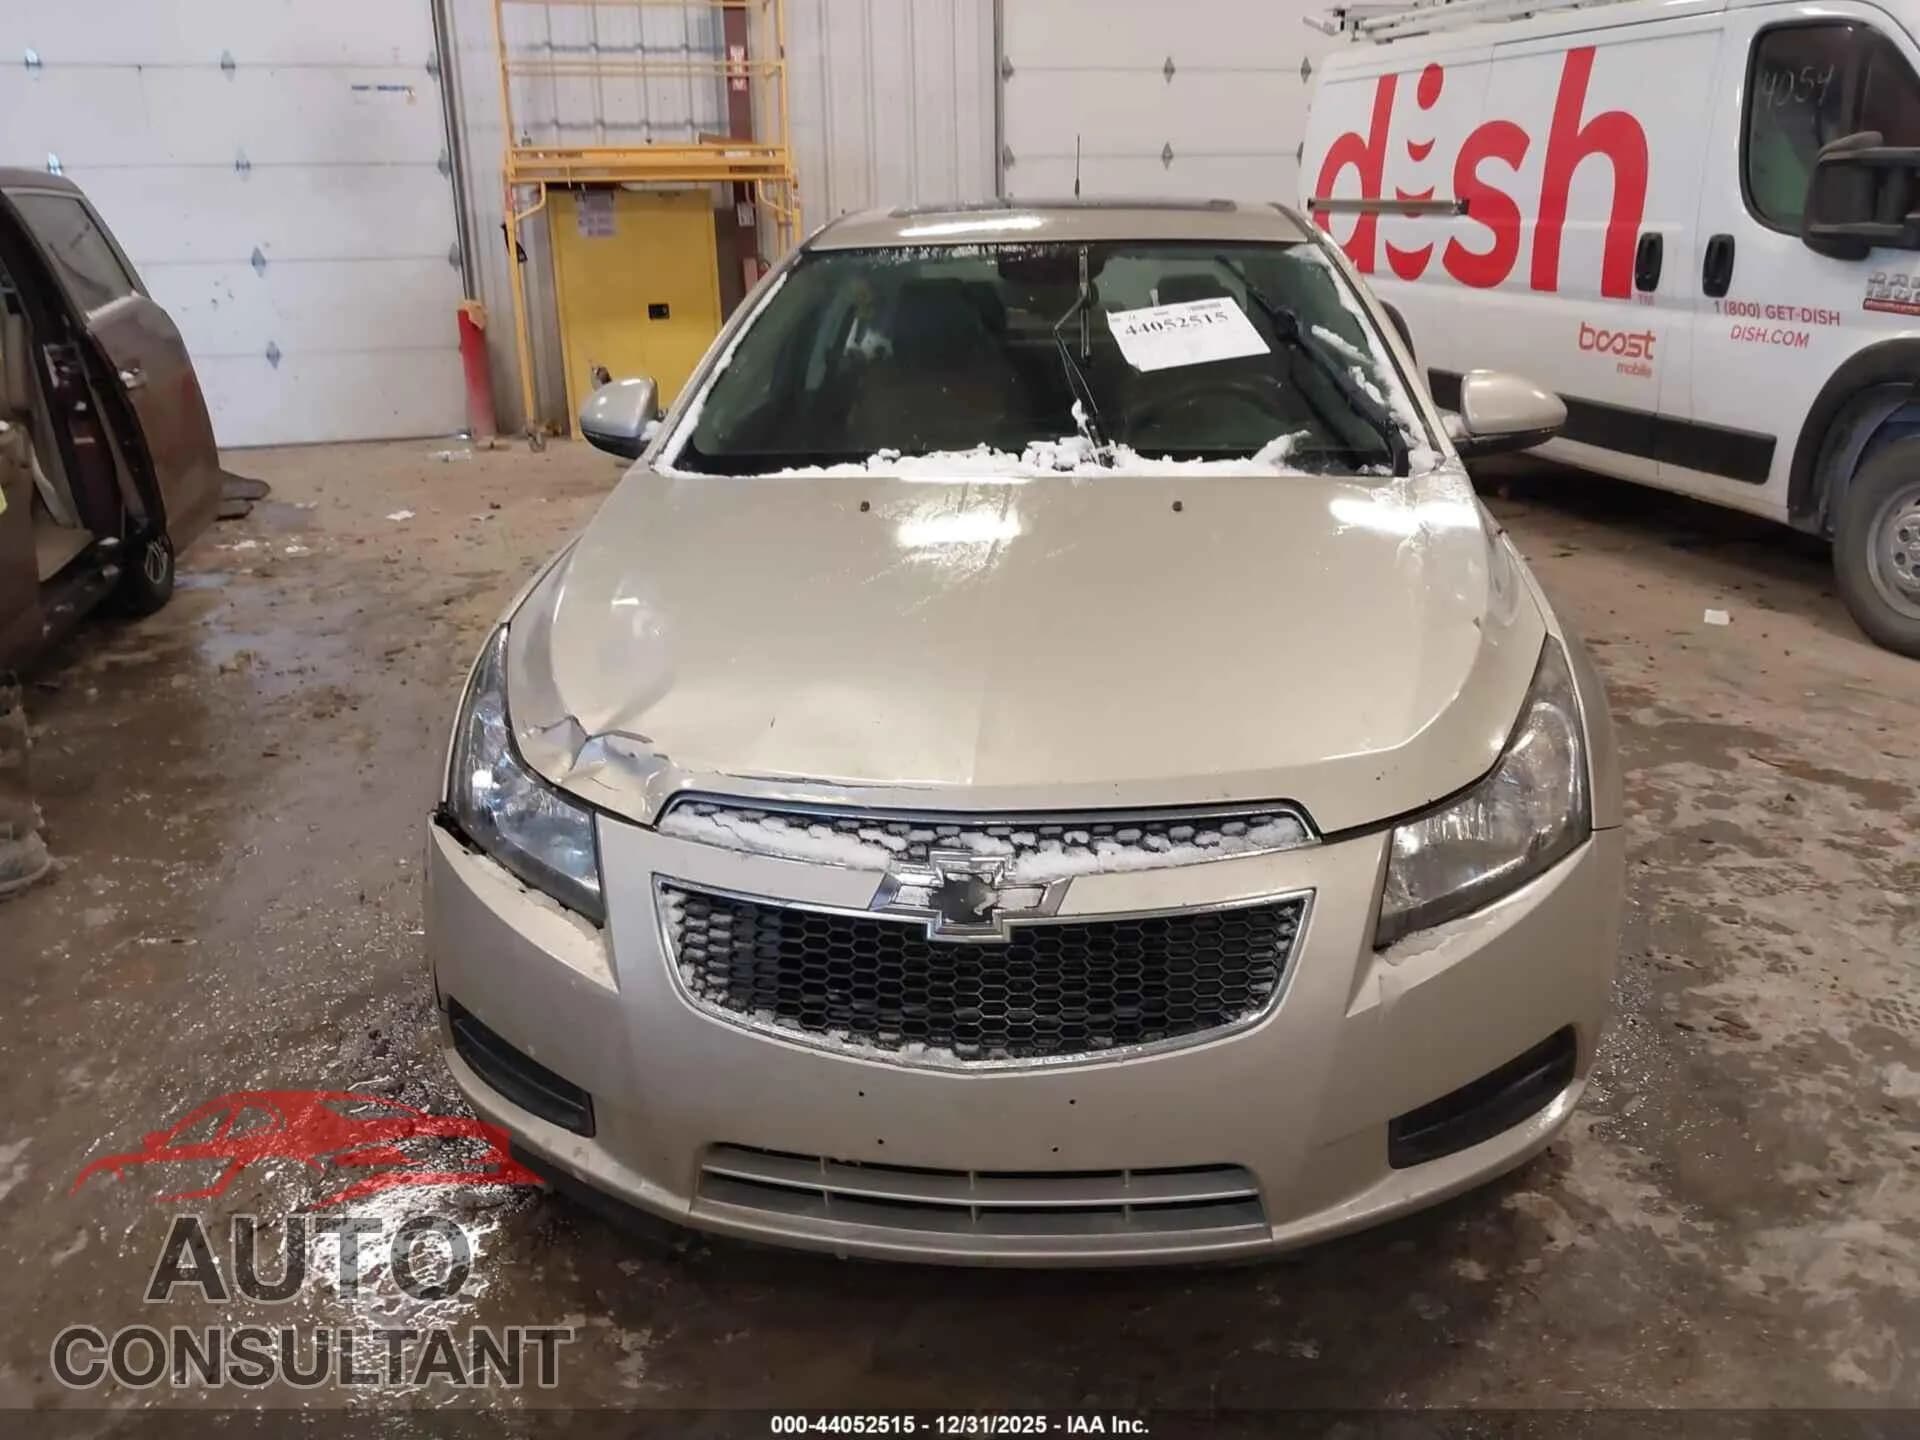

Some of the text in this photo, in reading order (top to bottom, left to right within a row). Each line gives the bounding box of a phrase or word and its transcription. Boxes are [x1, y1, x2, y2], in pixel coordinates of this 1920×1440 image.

[1314, 46, 1648, 298] dish
[1125, 311, 1229, 336] 44052515
[1724, 301, 1760, 319] (800)
[1765, 305, 1840, 326] GET-DISH
[1579, 321, 1656, 360] boost
[1730, 325, 1809, 349] DISH.COM
[1616, 361, 1653, 378] mobile
